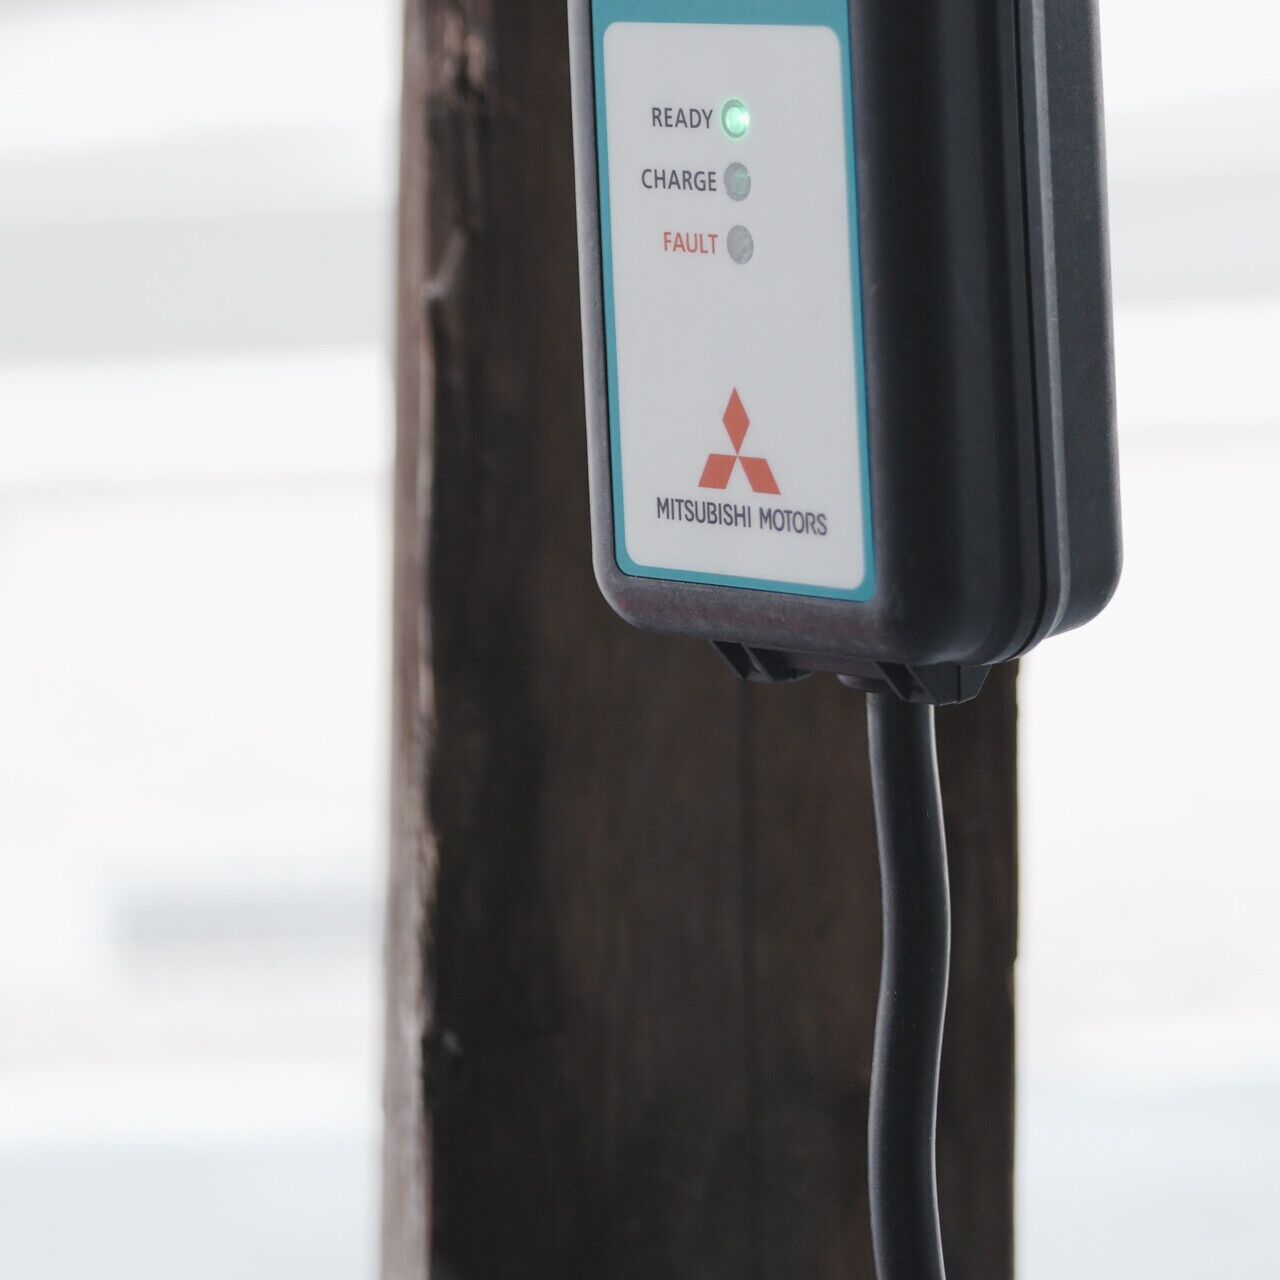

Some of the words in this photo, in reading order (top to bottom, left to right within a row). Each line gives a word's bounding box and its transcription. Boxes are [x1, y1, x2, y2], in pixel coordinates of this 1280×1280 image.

[651, 107, 713, 129] READY
[641, 168, 717, 192] CHARGE
[663, 231, 718, 254] FAULT
[656, 496, 751, 528] MITSUBISHI
[759, 507, 828, 536] MOTORS
